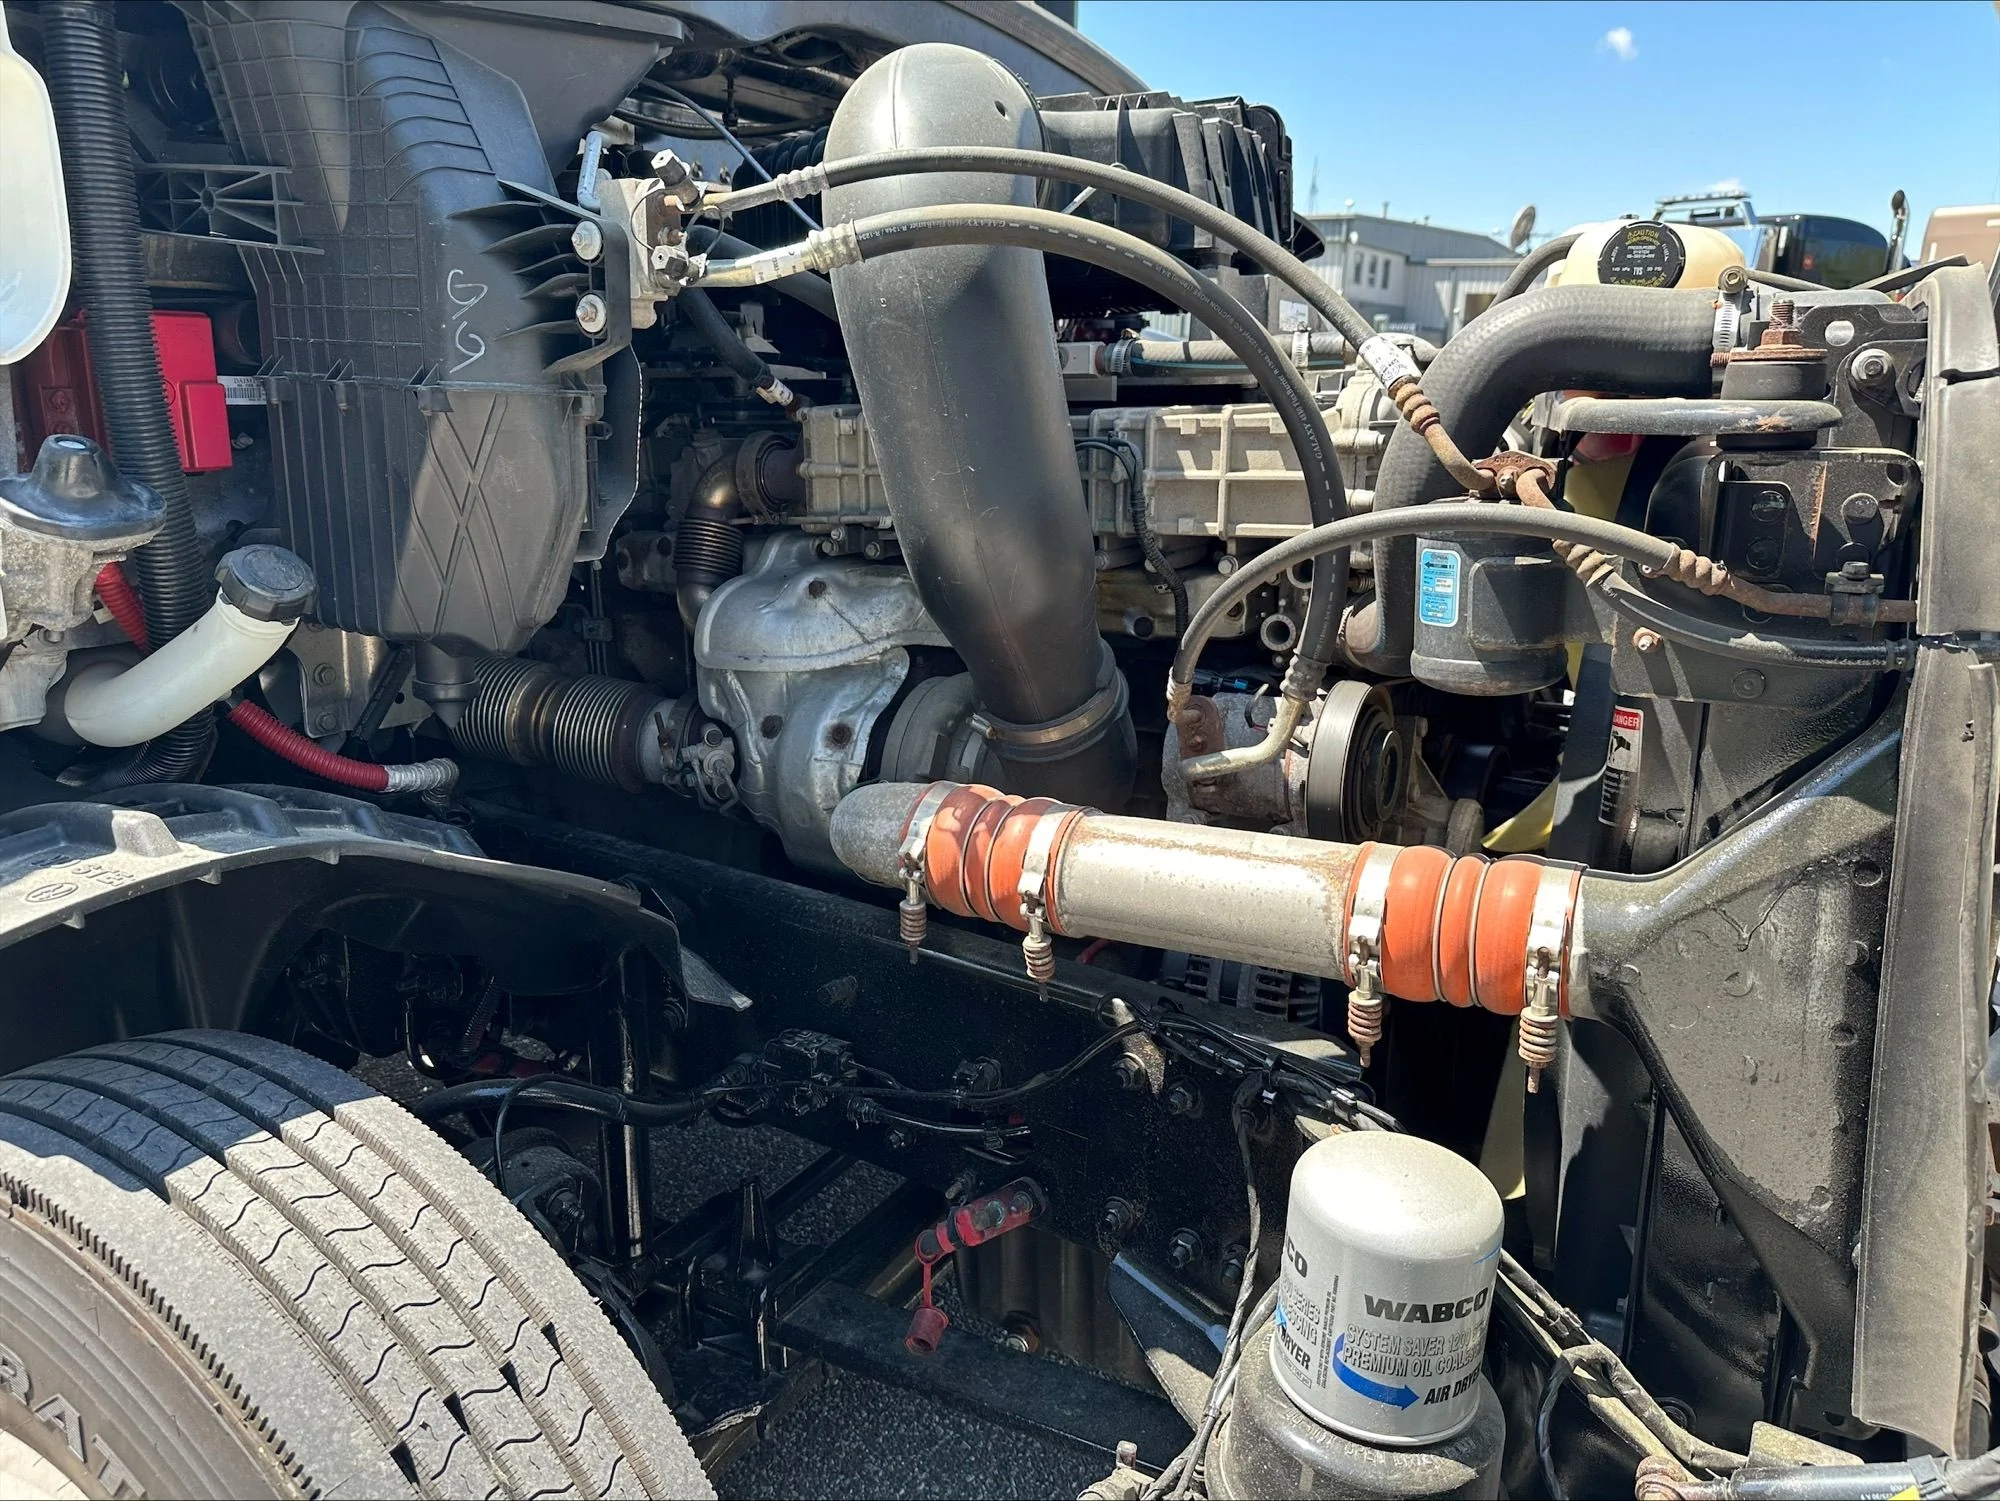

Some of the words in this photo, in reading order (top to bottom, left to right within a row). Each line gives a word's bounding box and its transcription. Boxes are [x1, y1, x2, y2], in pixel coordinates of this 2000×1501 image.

[1304, 423, 1323, 460] GALAXY
[1364, 1287, 1488, 1323] WABCO
[1346, 1323, 1402, 1356] SYSTEM
[1403, 1336, 1446, 1357] SAVER
[1449, 1329, 1472, 1353] 1200
[1343, 1344, 1409, 1377] PREMIUM
[1411, 1358, 1433, 1377] OIL
[1423, 1385, 1452, 1405] AIR
